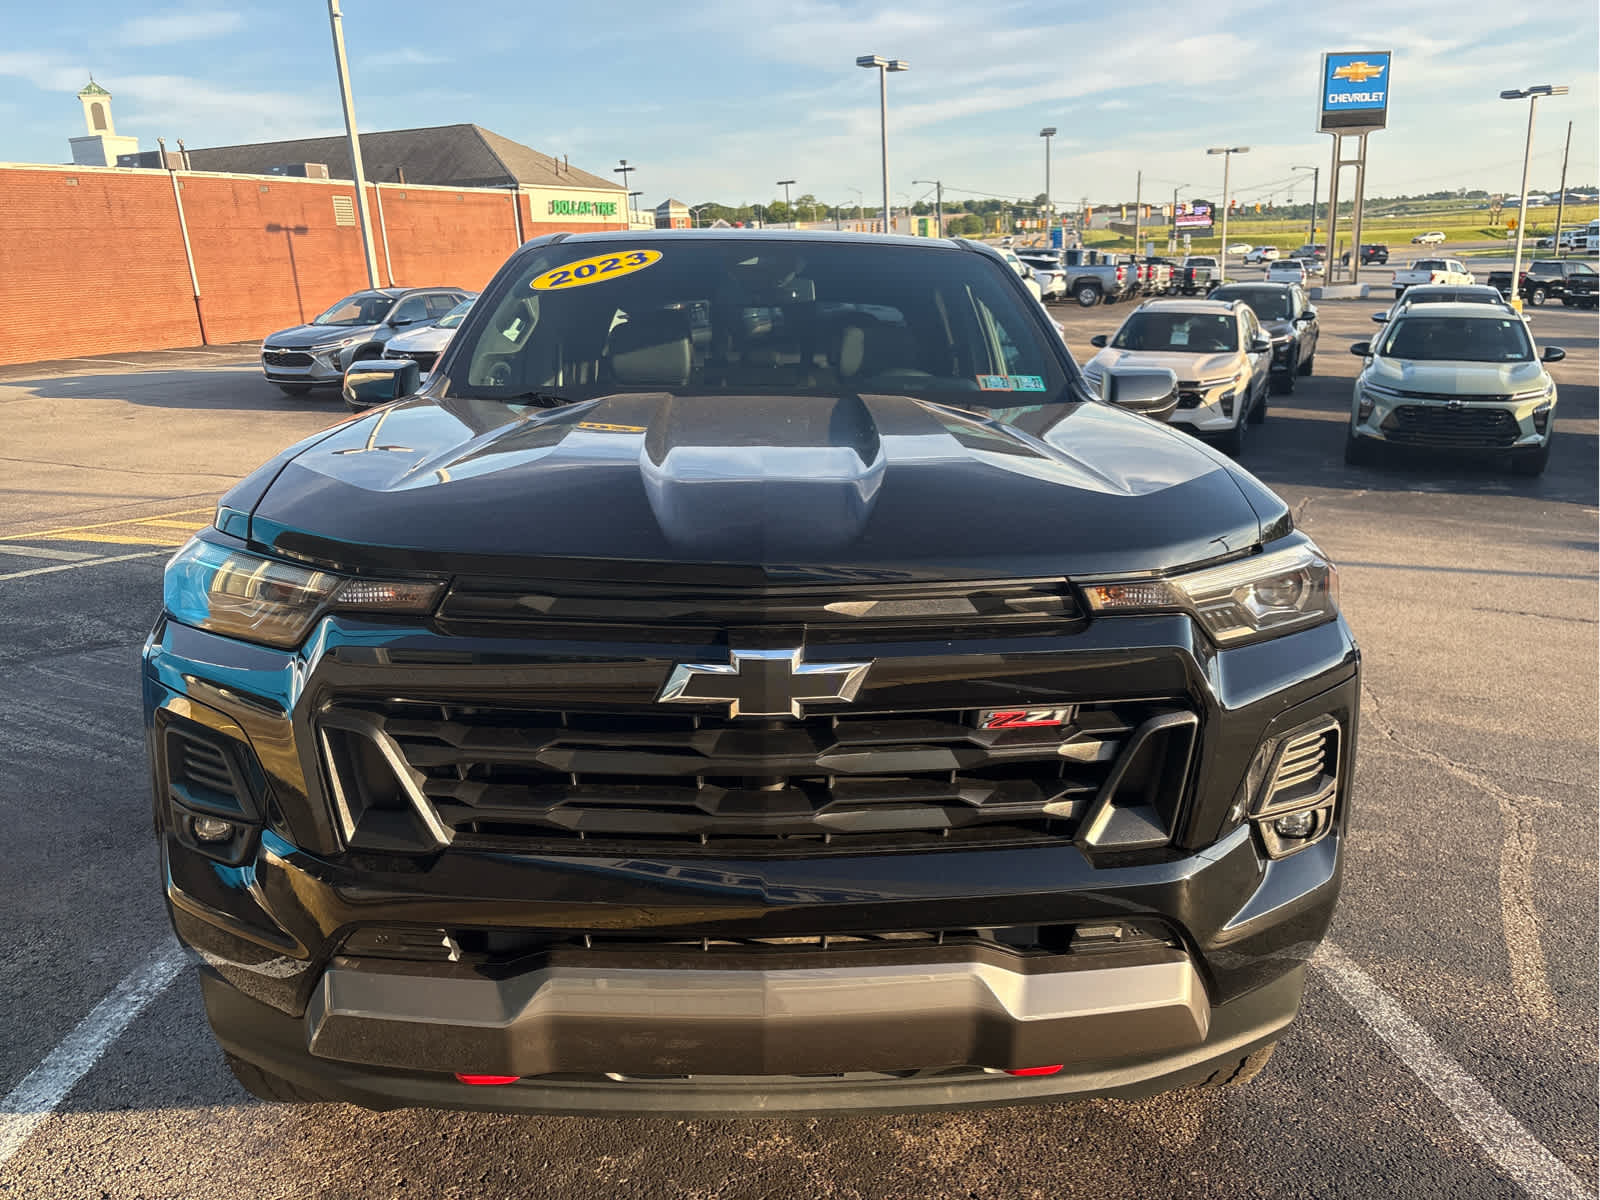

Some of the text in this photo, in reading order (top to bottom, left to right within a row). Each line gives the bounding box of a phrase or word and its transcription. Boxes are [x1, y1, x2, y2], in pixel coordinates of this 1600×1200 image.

[1328, 92, 1385, 104] CHEVROLET
[552, 200, 617, 216] DOLLAR TREE
[549, 252, 649, 287] 2023
[981, 709, 1068, 729] Z71
